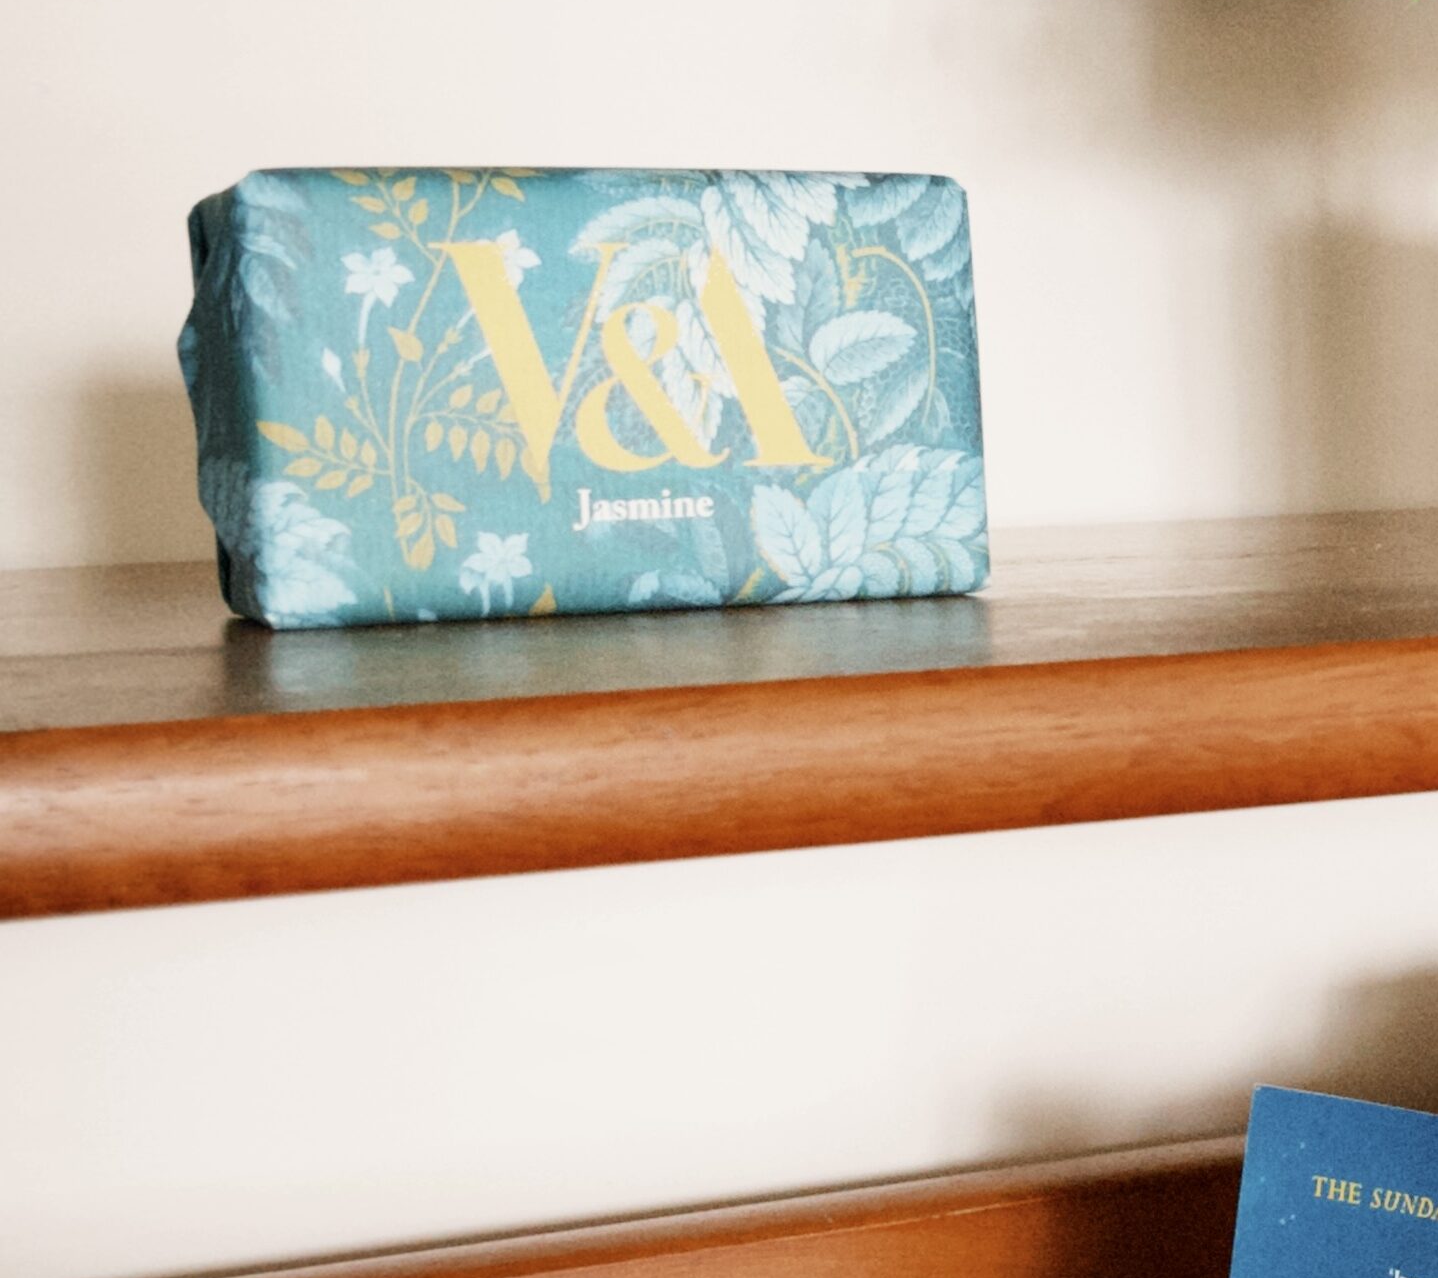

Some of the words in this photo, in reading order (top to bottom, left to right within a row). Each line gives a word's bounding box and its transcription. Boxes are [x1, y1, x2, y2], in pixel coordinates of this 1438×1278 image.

[429, 240, 836, 503] V&A
[574, 490, 715, 530] Jasmine
[1311, 1174, 1363, 1205] THE
